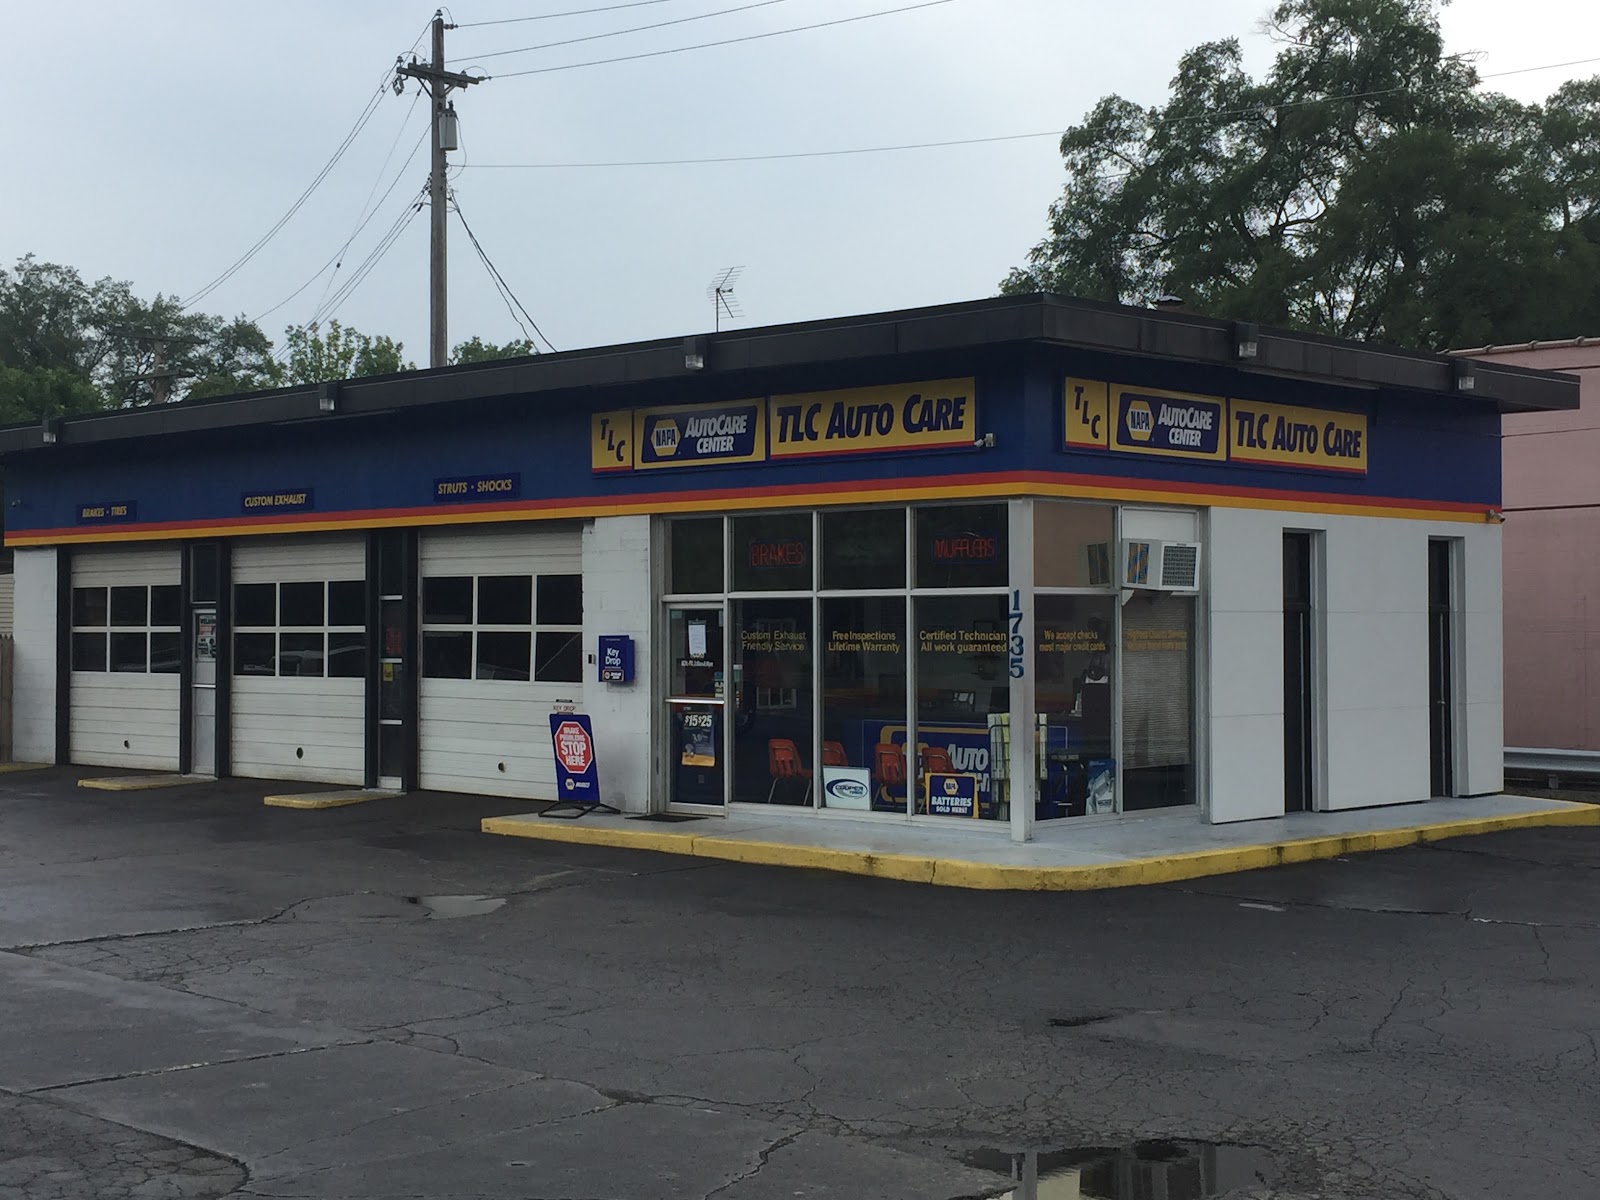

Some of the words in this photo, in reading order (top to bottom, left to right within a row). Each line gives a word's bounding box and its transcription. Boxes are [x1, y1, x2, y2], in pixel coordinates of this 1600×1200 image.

[777, 403, 822, 443] TLC
[825, 402, 895, 439] AUTO
[903, 394, 967, 433] CARE
[1074, 386, 1101, 439] TLC
[1130, 410, 1151, 431] NAPA
[601, 418, 626, 462] TLC
[655, 428, 676, 447] NAPA
[1168, 428, 1201, 447] CENTER
[1235, 411, 1269, 449] TLC
[1271, 416, 1319, 454] AUTO
[1323, 421, 1362, 458] CARE
[696, 435, 734, 454] CENTER
[437, 481, 468, 494] STRUTS
[477, 479, 512, 492] SHOCKS
[244, 495, 274, 507] CUSTOM
[274, 493, 307, 505] EXHAUST
[752, 542, 804, 567] BRAKES
[934, 538, 995, 558] MUFFLERS
[741, 630, 771, 640] Custom
[773, 630, 806, 640] Exhaust
[832, 630, 849, 640] Free
[849, 630, 896, 642] Inspections
[919, 630, 957, 641] Certified
[958, 630, 1007, 641] Technician
[1008, 589, 1025, 679] 1735
[1043, 630, 1055, 640] We
[1055, 631, 1077, 642] accept
[1077, 629, 1098, 640] checks
[606, 647, 620, 658] Key
[741, 641, 773, 652] Friendly
[774, 641, 805, 651] Service
[828, 641, 861, 652] Lifetime
[862, 642, 901, 654] Warranty
[920, 642, 933, 652] All
[934, 642, 956, 652] work
[957, 642, 1008, 654] guaranteed
[1039, 643, 1055, 652] most
[1055, 642, 1072, 653] major
[1072, 642, 1089, 652] credit
[1089, 642, 1106, 652] cards
[605, 656, 622, 667] Drop
[684, 714, 698, 727] $15
[698, 714, 713, 728] $25
[561, 741, 587, 756] STOP
[565, 755, 586, 767] HERE
[947, 743, 989, 771] AUTO
[931, 796, 972, 808] BATTERIES
[935, 806, 951, 814] SOLD
